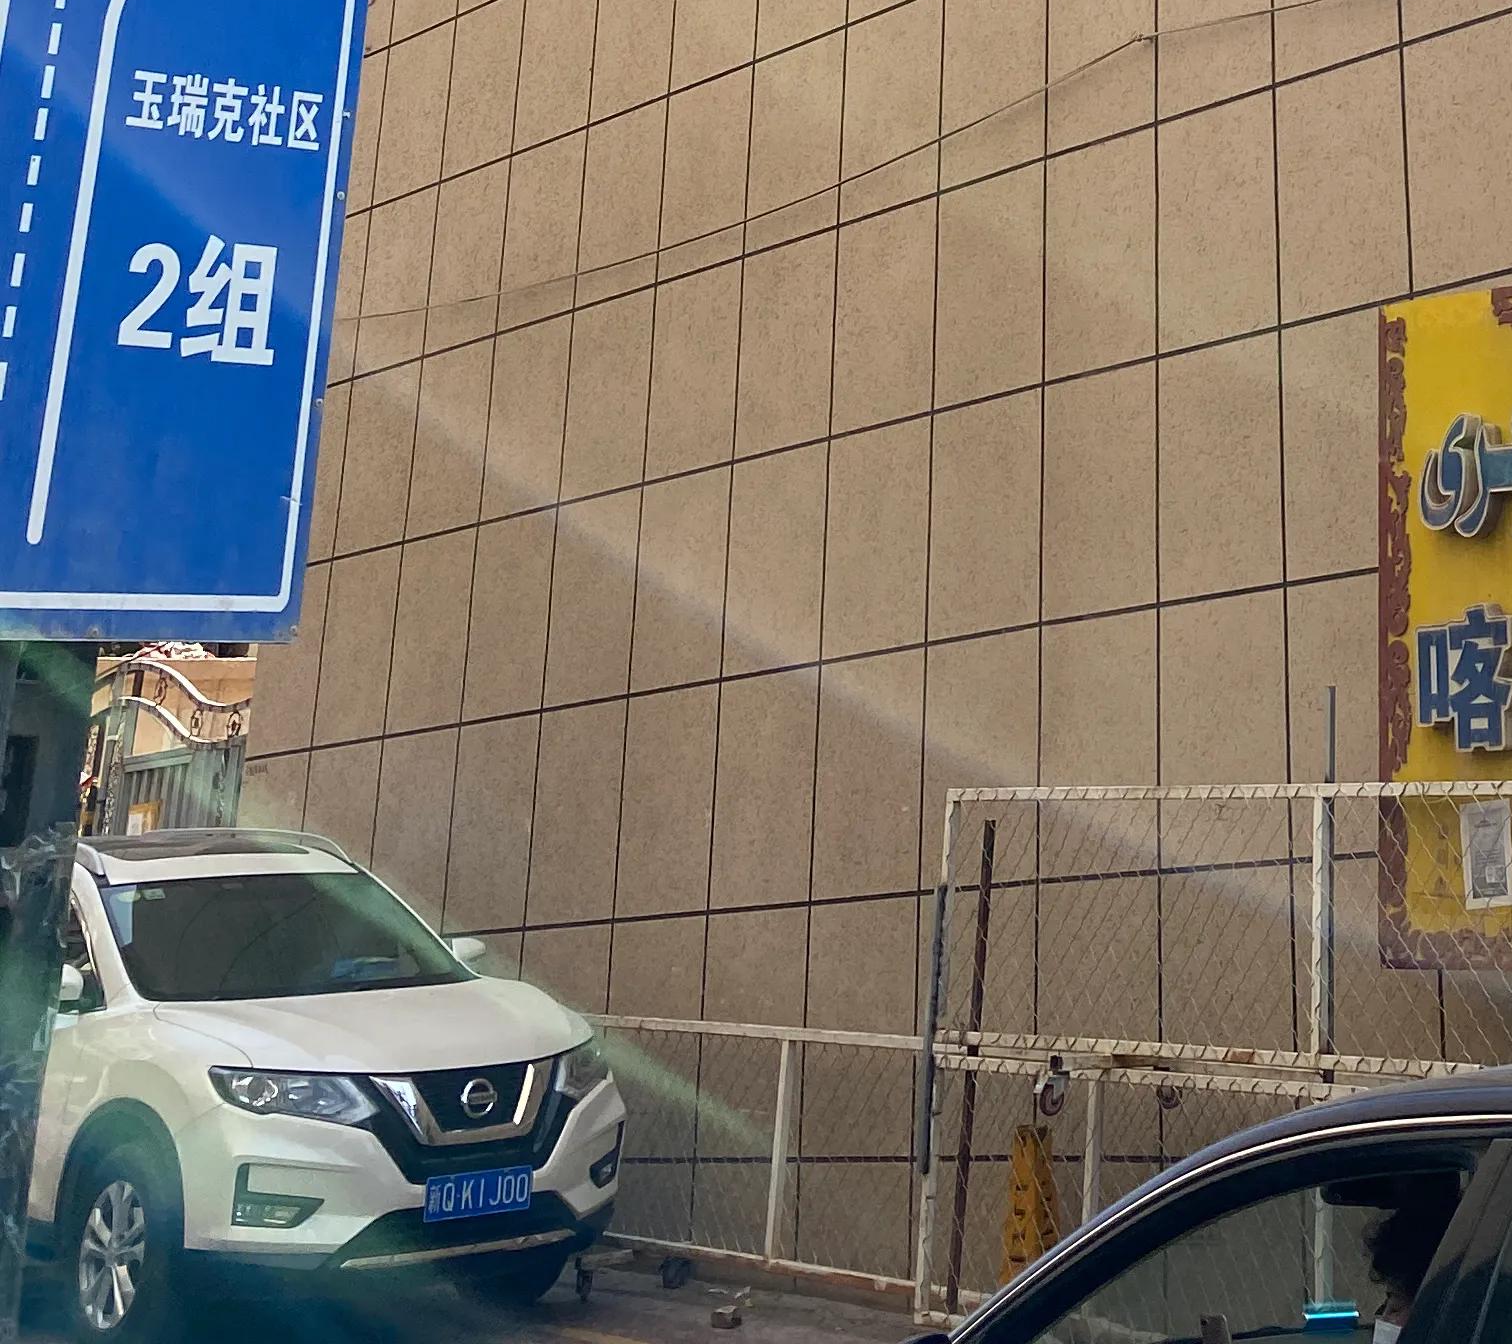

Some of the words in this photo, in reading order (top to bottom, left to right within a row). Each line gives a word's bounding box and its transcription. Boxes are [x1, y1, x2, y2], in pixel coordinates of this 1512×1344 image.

[125, 70, 321, 152] 玉瑞克社区
[118, 234, 278, 366] 2组
